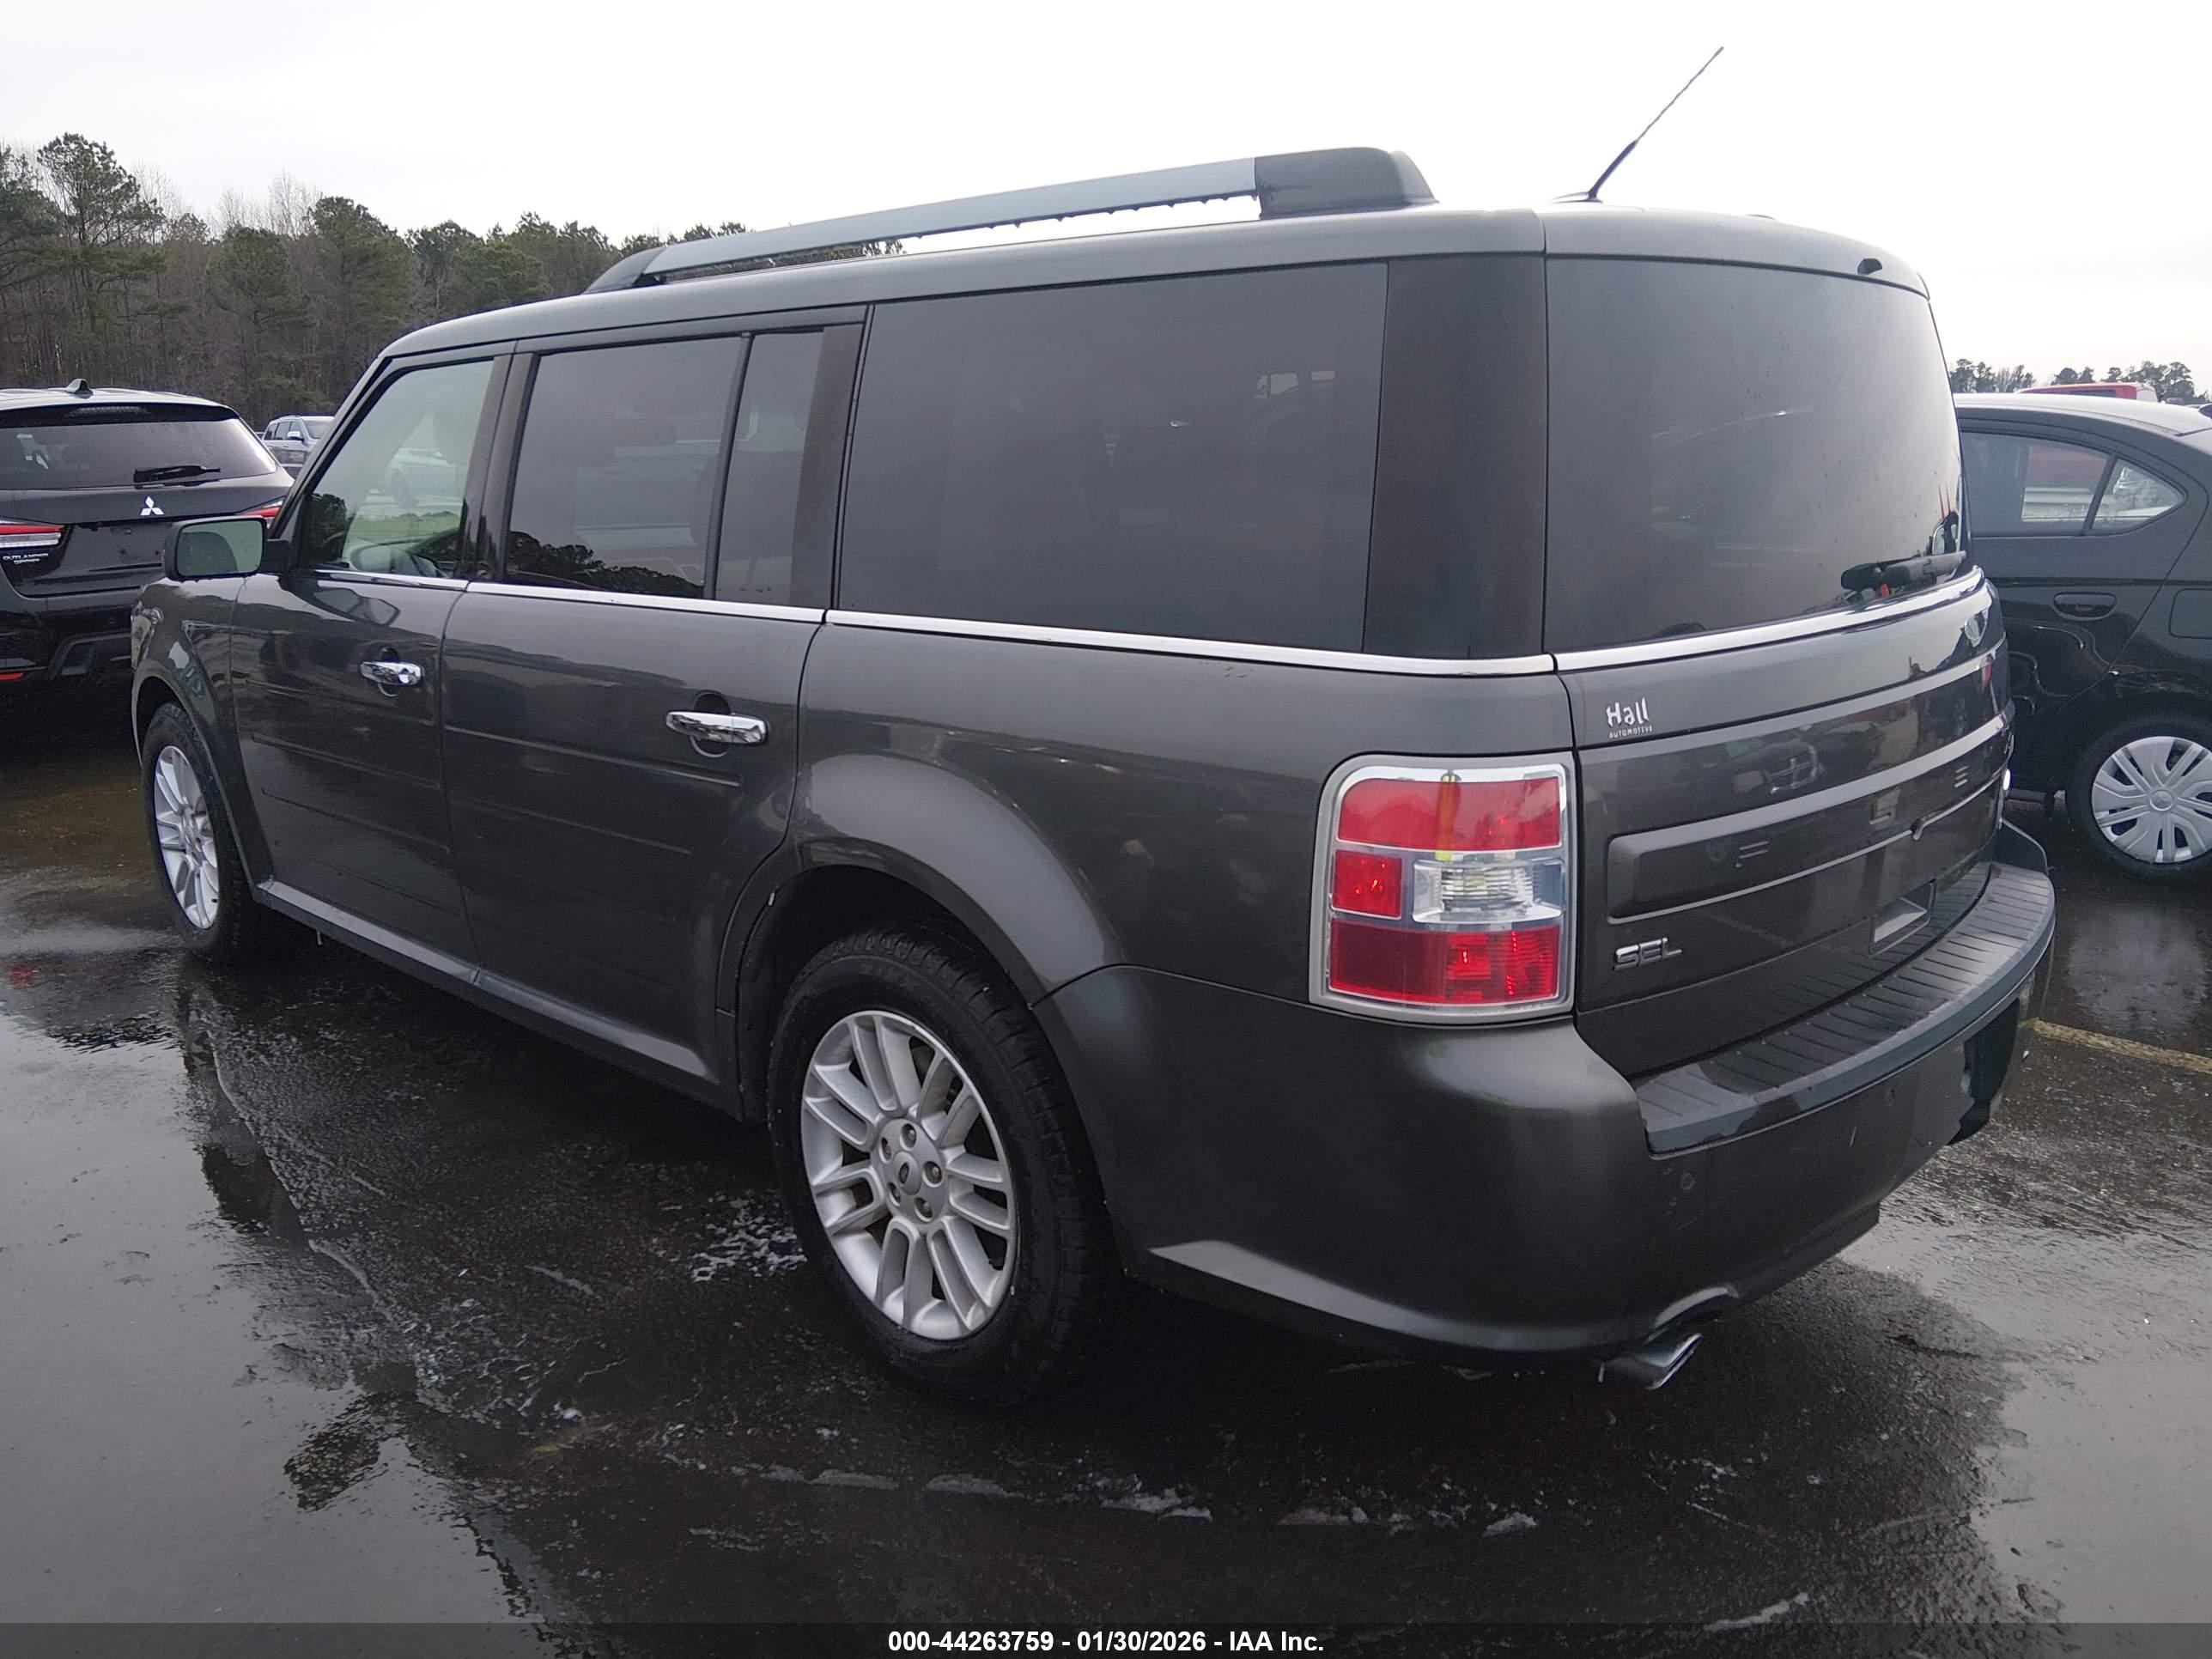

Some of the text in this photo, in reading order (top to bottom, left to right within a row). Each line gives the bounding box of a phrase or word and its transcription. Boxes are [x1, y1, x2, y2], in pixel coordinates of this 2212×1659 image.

[1606, 696, 1650, 727] Hall
[1608, 725, 1653, 738] AUTOMOTIVE
[1613, 937, 1683, 971] SEL
